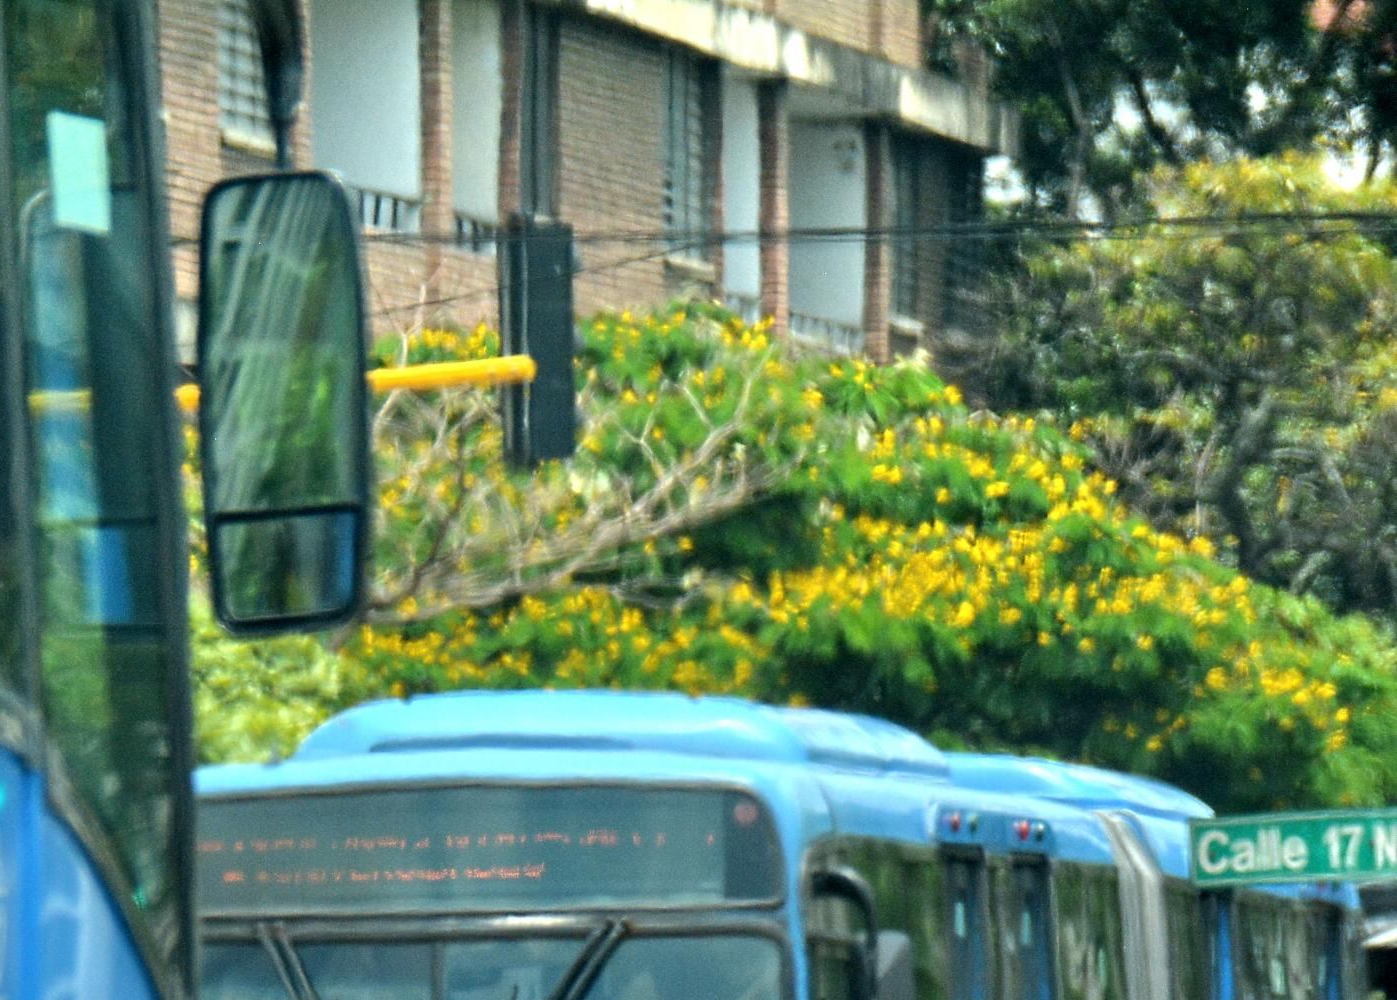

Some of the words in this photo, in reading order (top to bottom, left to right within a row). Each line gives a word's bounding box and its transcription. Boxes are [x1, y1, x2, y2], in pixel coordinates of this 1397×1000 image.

[1198, 827, 1309, 874] Calle
[1322, 825, 1364, 869] 17
[1372, 821, 1397, 868] N
